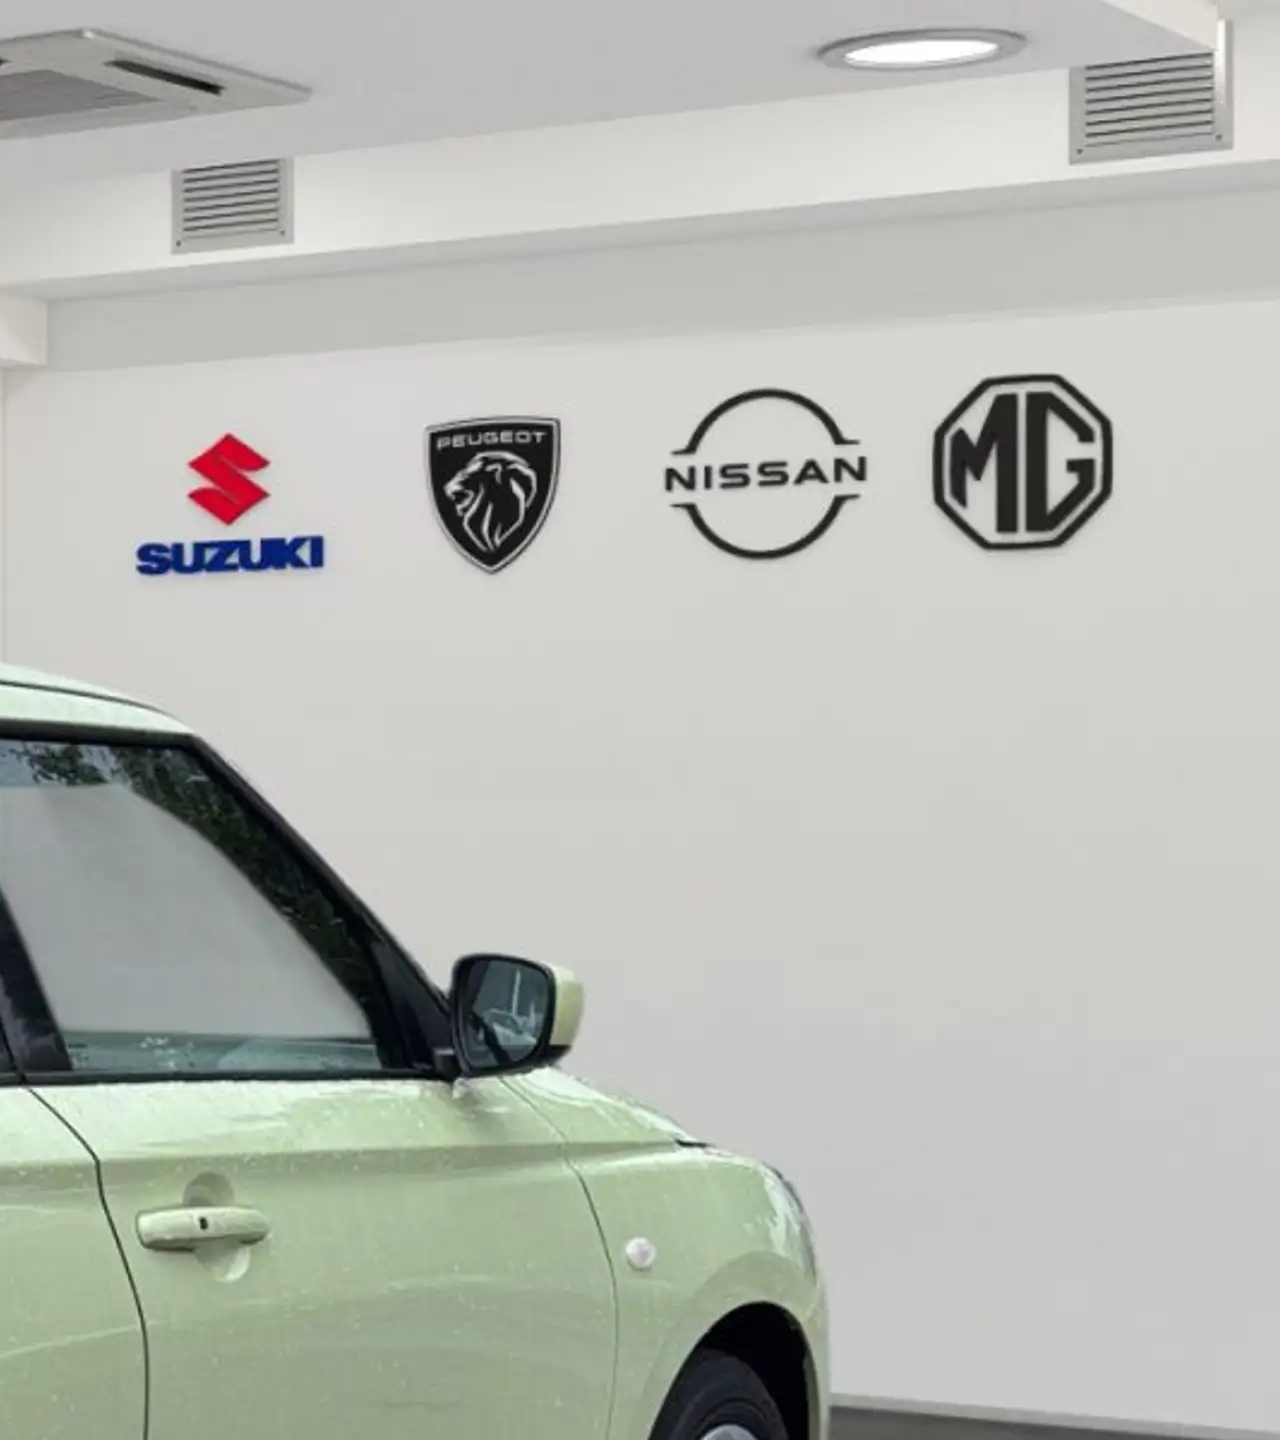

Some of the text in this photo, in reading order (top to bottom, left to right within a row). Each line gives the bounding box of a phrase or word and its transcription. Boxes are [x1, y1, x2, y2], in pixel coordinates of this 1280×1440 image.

[437, 430, 548, 450] PEUGEOT
[665, 456, 867, 493] NISSAN
[949, 391, 1098, 534] MG
[136, 536, 326, 576] SUZUKI
